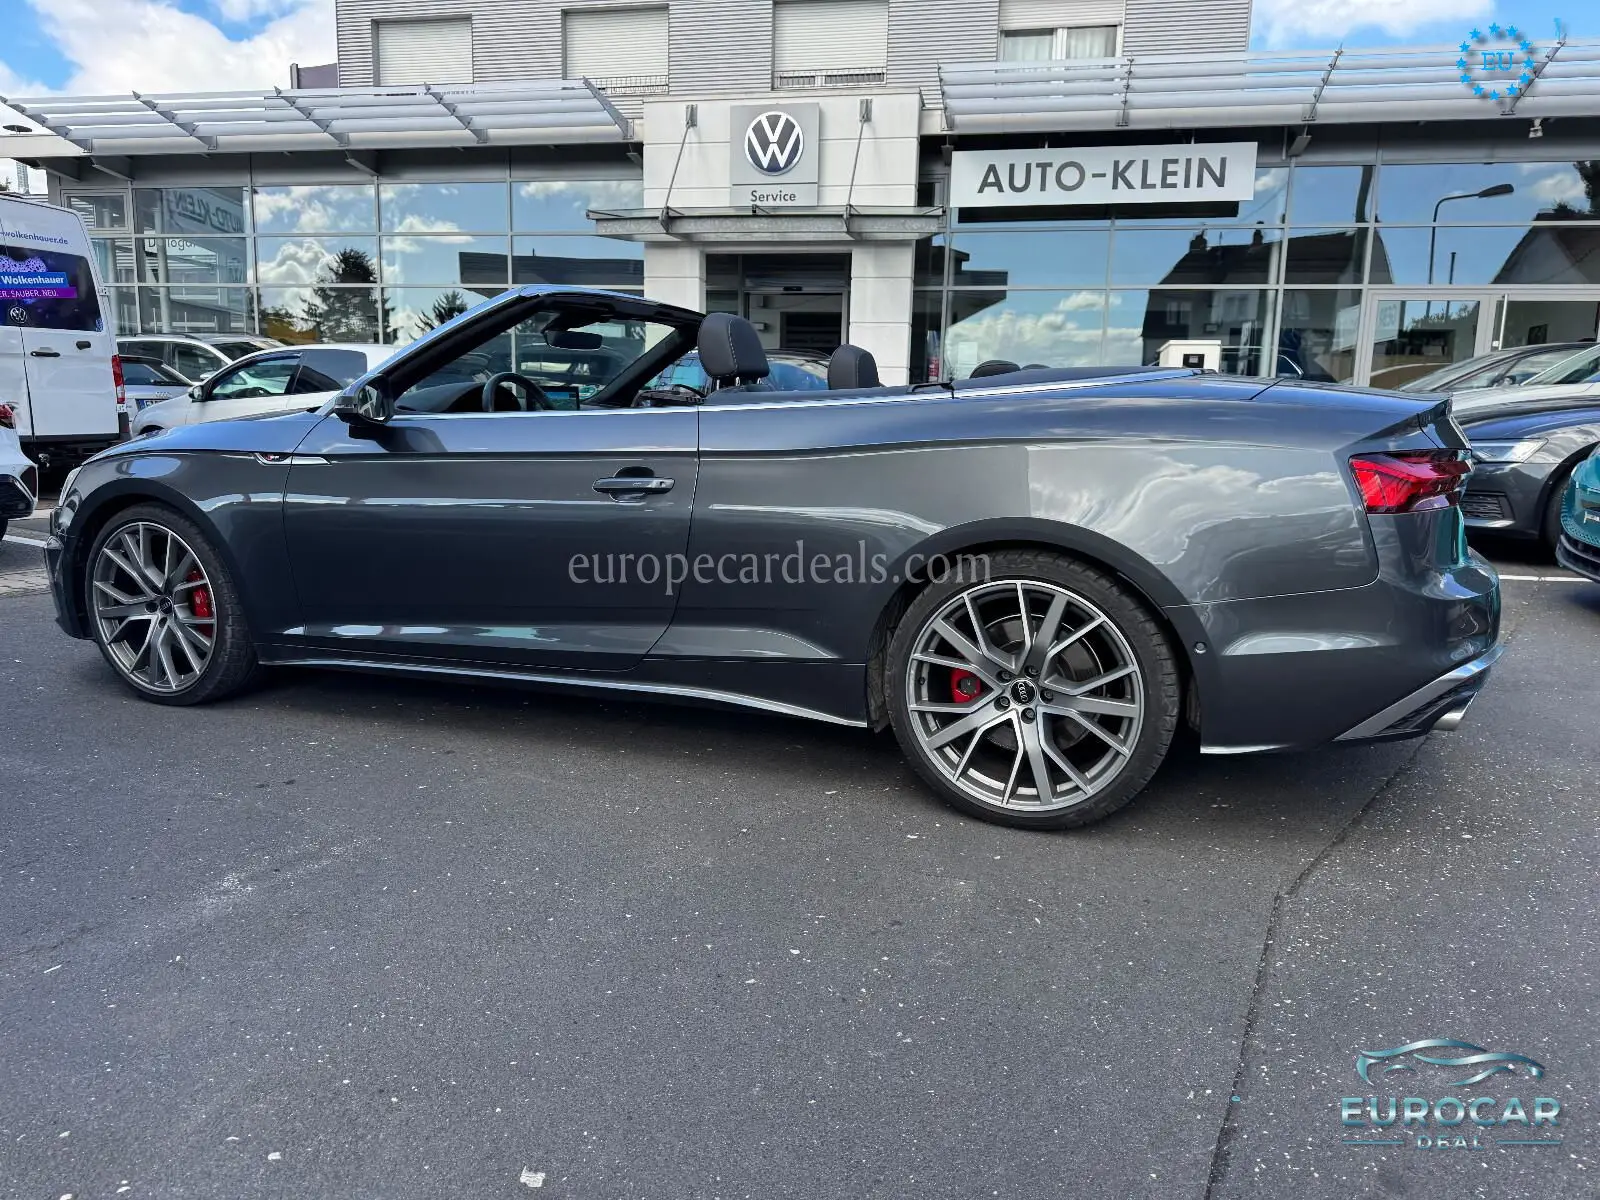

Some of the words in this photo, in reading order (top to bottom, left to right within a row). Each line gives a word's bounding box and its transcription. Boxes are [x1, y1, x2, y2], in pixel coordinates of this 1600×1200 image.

[977, 156, 1228, 194] AUTO-KLEIN
[750, 189, 796, 203] Service
[1, 275, 64, 284] Wolkenhauer
[11, 289, 41, 297] SAUBER.
[42, 289, 59, 297] NEU.
